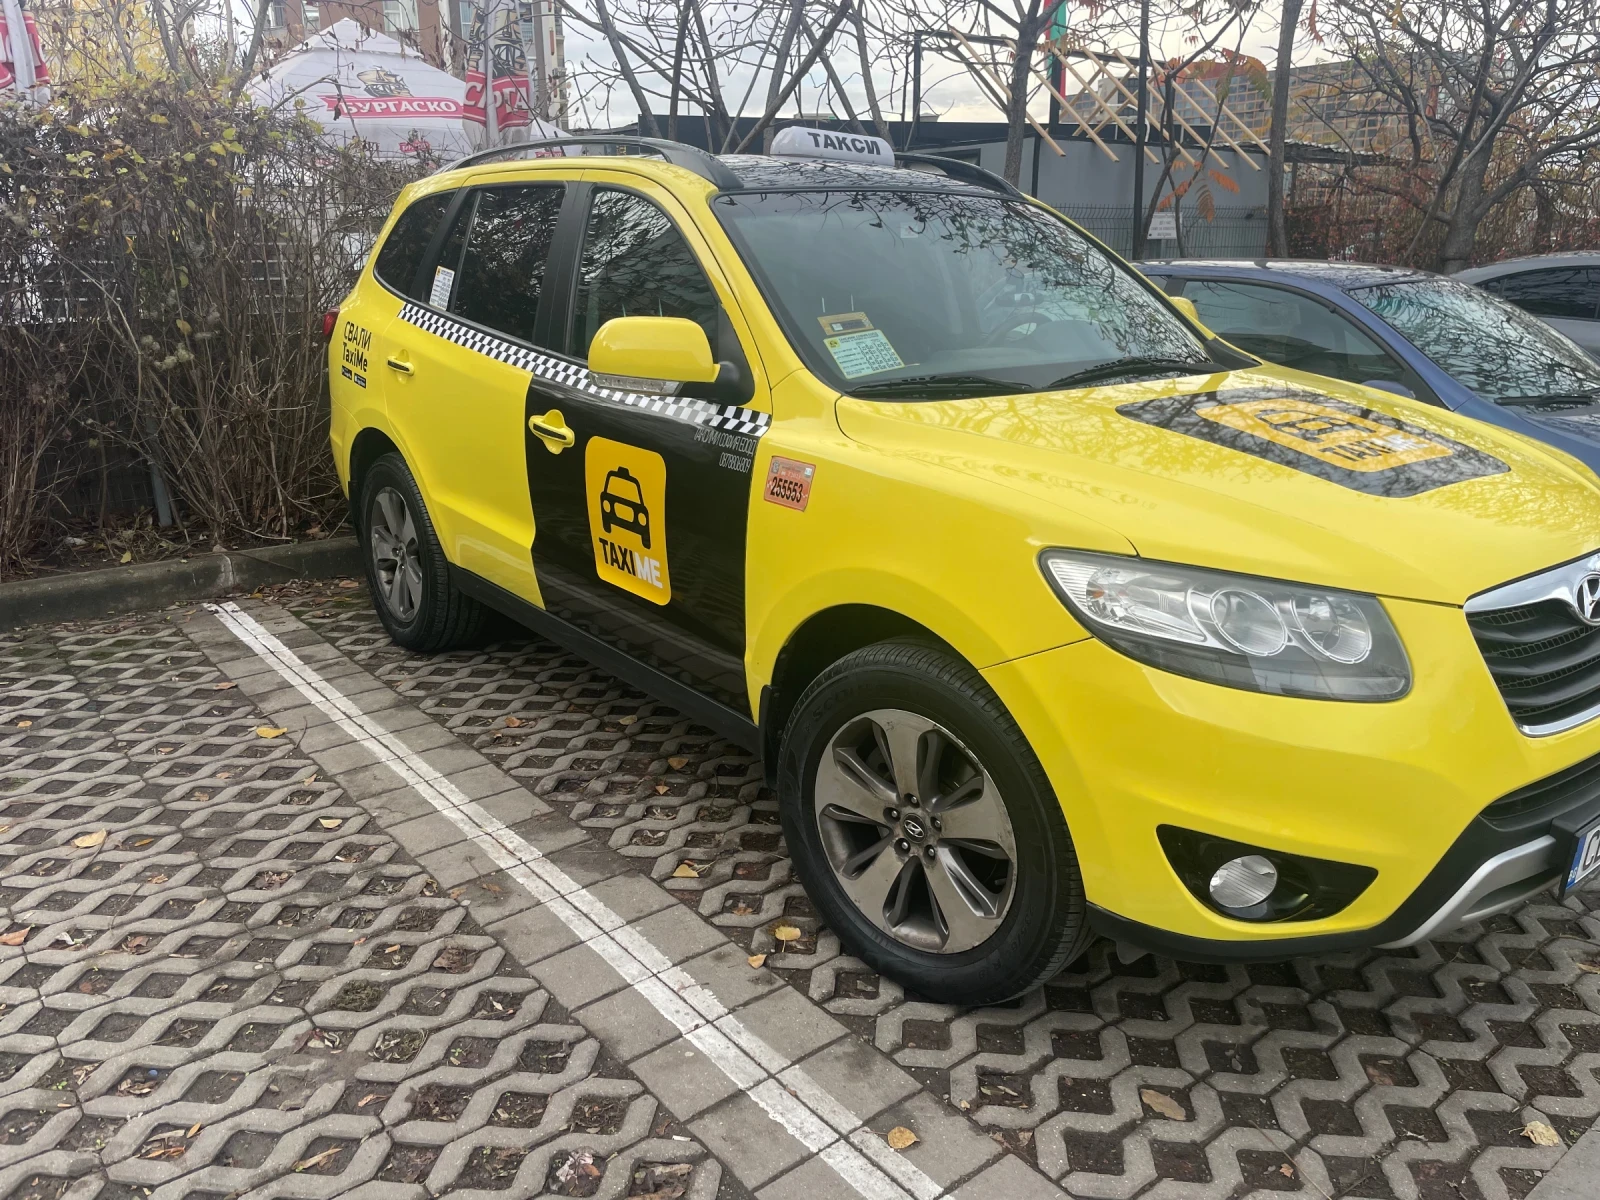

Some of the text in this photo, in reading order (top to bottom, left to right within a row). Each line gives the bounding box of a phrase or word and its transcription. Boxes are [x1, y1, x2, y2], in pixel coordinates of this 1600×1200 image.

[340, 99, 457, 114] БУРГАСКО
[807, 132, 881, 155] ТАКСИ
[344, 321, 371, 351] СВАЛИ
[343, 342, 367, 372] TaxiMe
[770, 476, 804, 503] 255553
